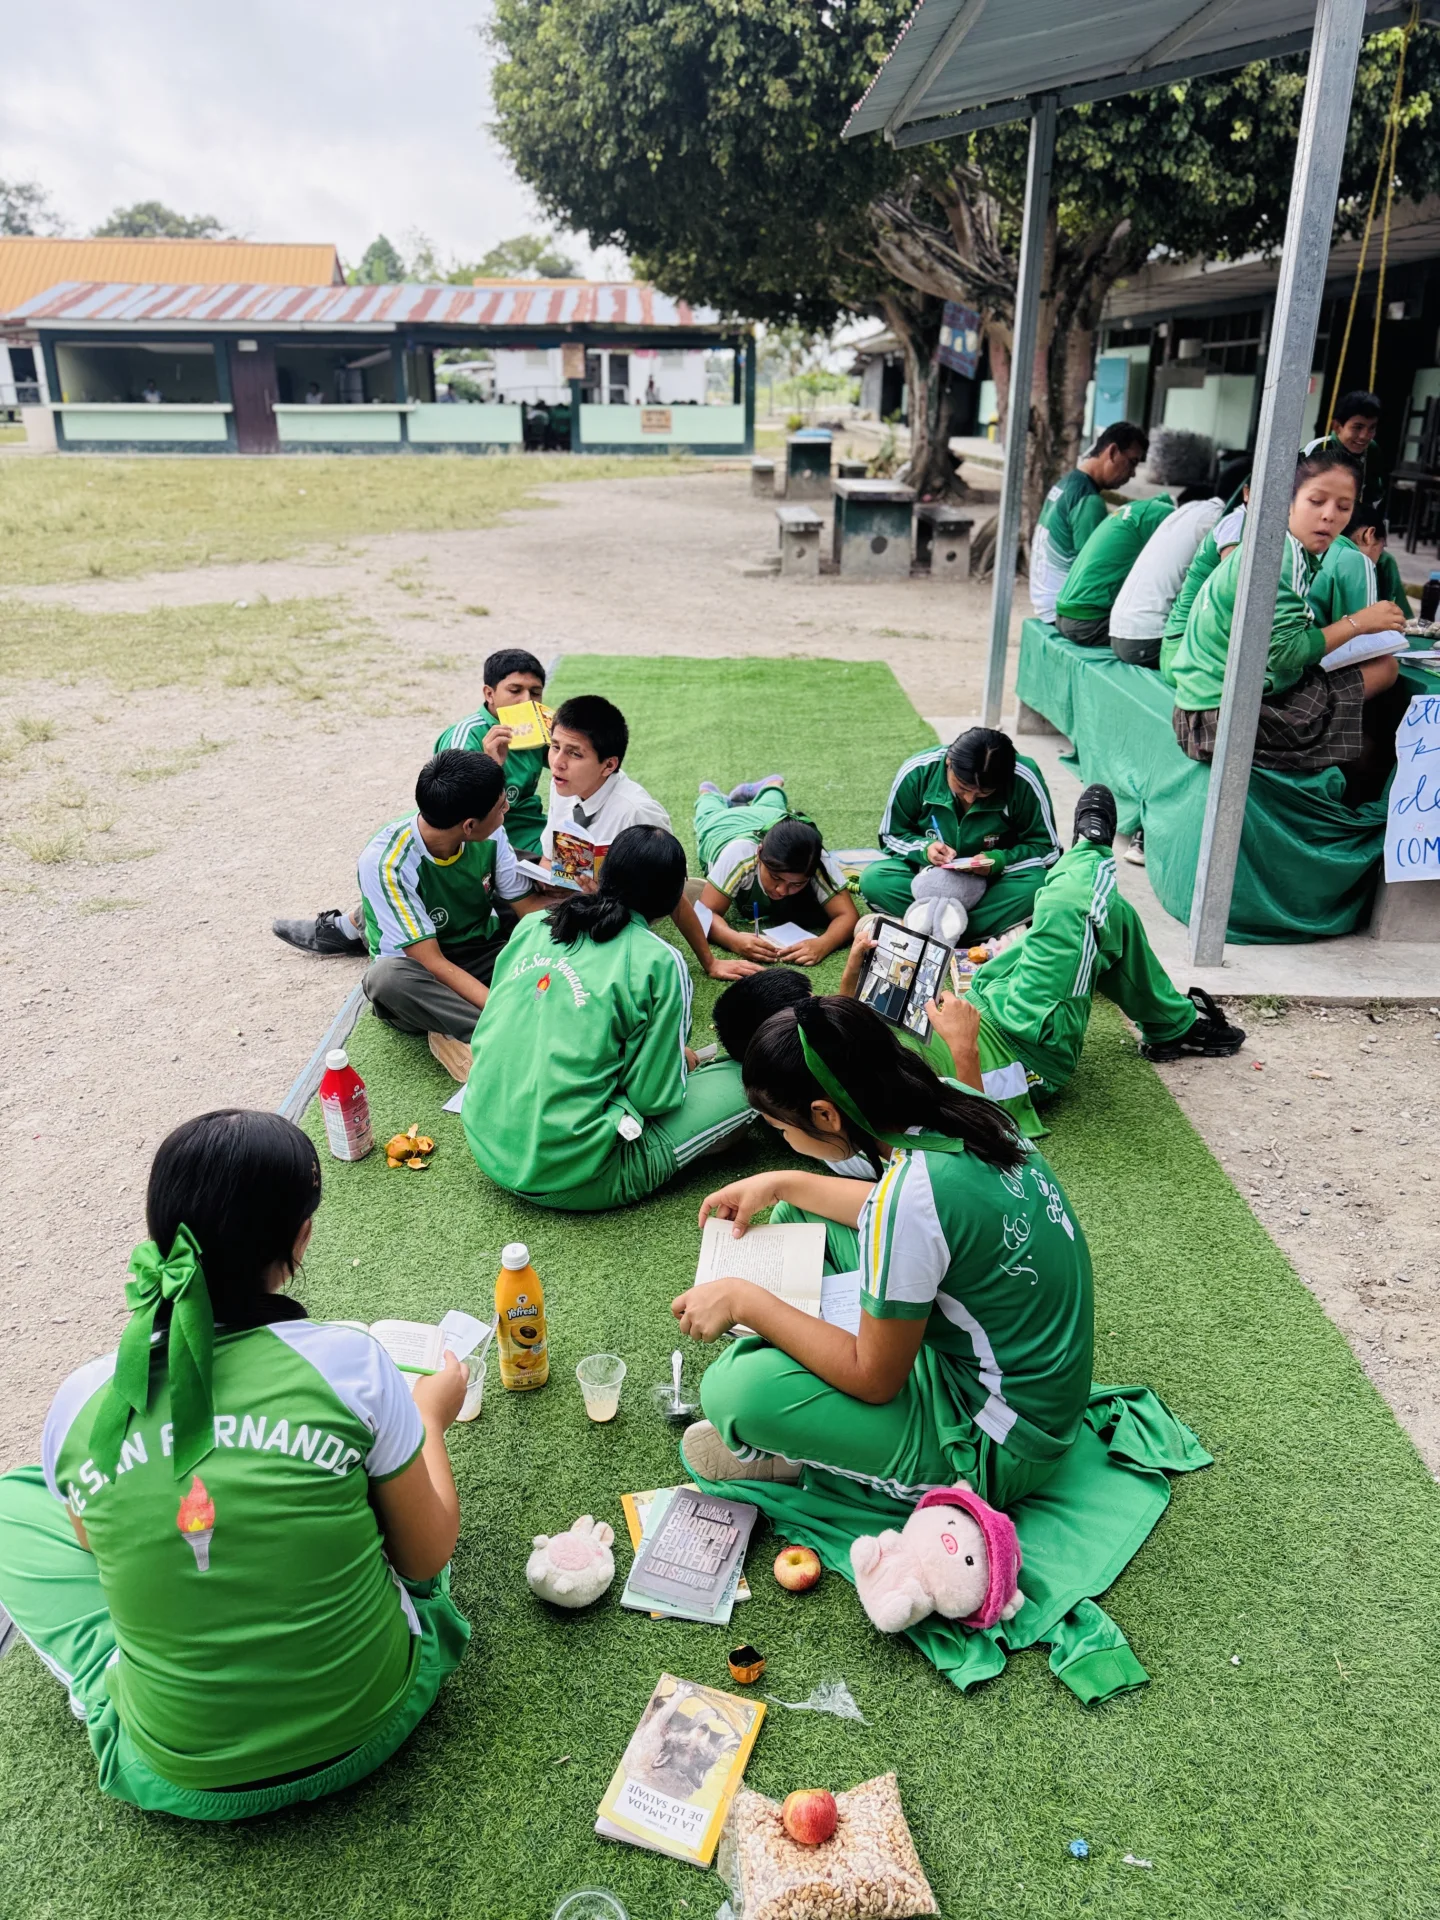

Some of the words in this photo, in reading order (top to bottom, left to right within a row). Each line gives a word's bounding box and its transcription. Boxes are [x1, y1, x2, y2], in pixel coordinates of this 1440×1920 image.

[431, 911, 445, 924] SF
[551, 956, 591, 1008] Fernando
[507, 1304, 539, 1320] Yofresh
[79, 1432, 149, 1495] SN
[160, 1414, 361, 1477] FRNANDO
[696, 1509, 732, 1525] EDITORIAL
[700, 1503, 730, 1516] ALIANZA
[659, 1525, 710, 1554] ENTRE
[652, 1541, 721, 1574] CENTENO
[669, 1566, 717, 1590] Salinger
[627, 1783, 669, 1809] SALVAJE
[628, 1795, 678, 1826] LLAMADA
[671, 1804, 686, 1816] LO
[688, 1810, 704, 1823] DE
[682, 1820, 696, 1832] LA
